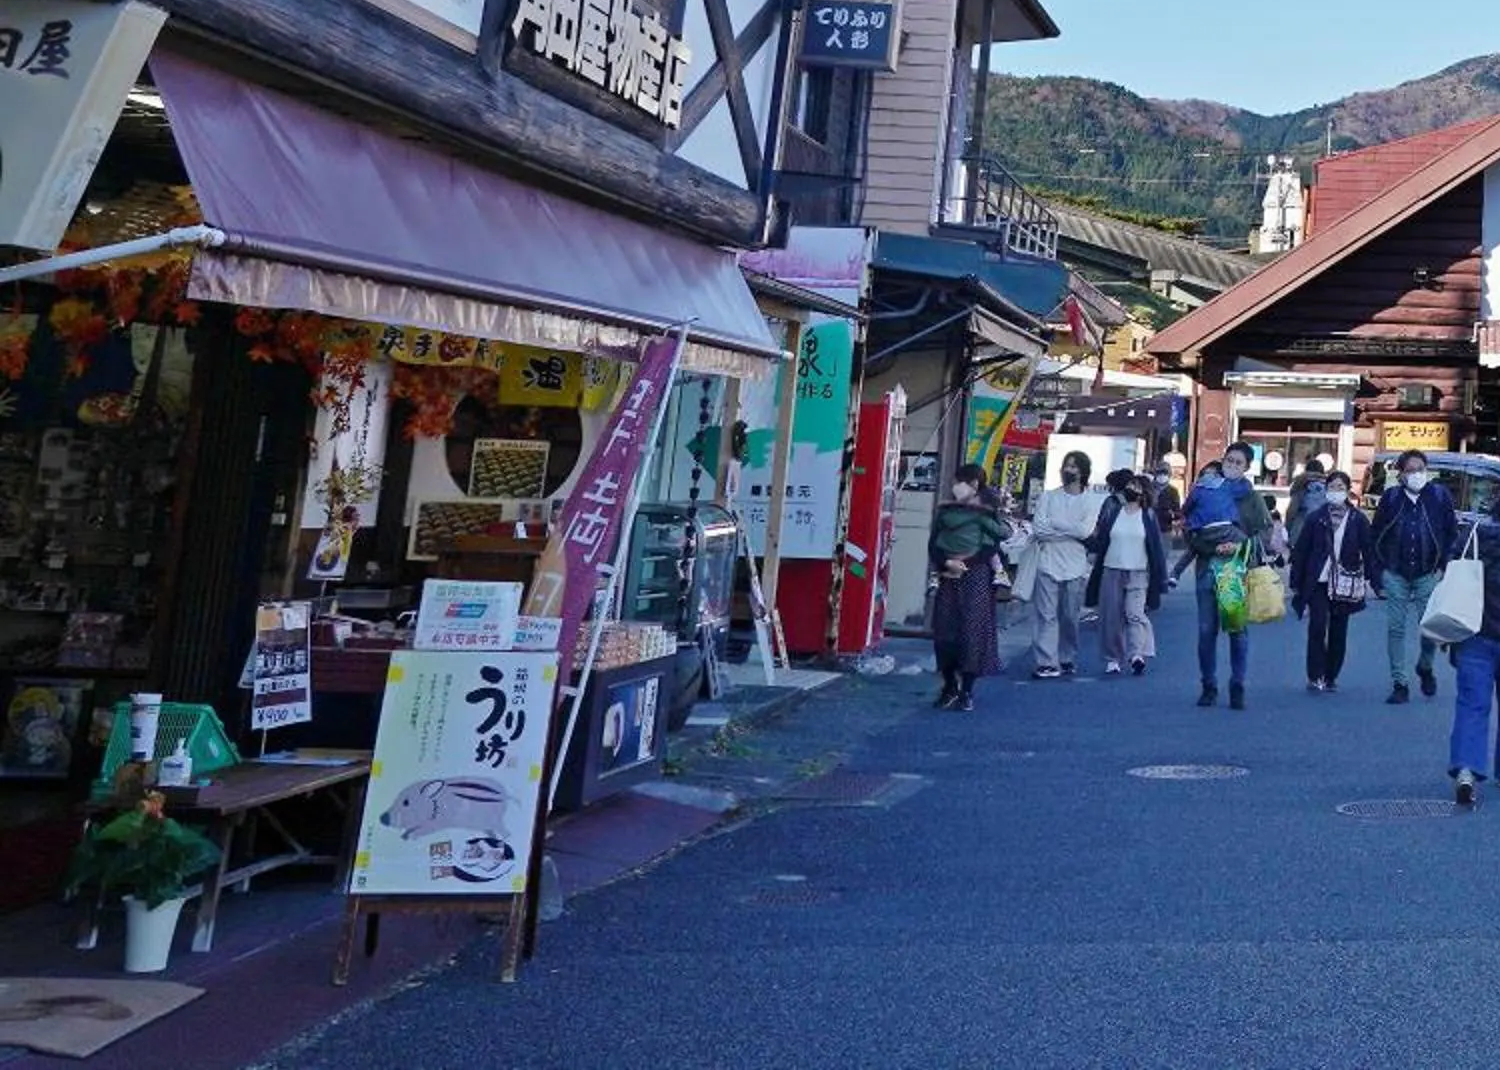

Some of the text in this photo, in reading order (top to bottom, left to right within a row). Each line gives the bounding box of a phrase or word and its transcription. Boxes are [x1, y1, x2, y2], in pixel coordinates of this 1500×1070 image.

[814, 6, 886, 29] てりふり
[825, 30, 870, 50] 人形
[465, 665, 526, 769] うり坊
